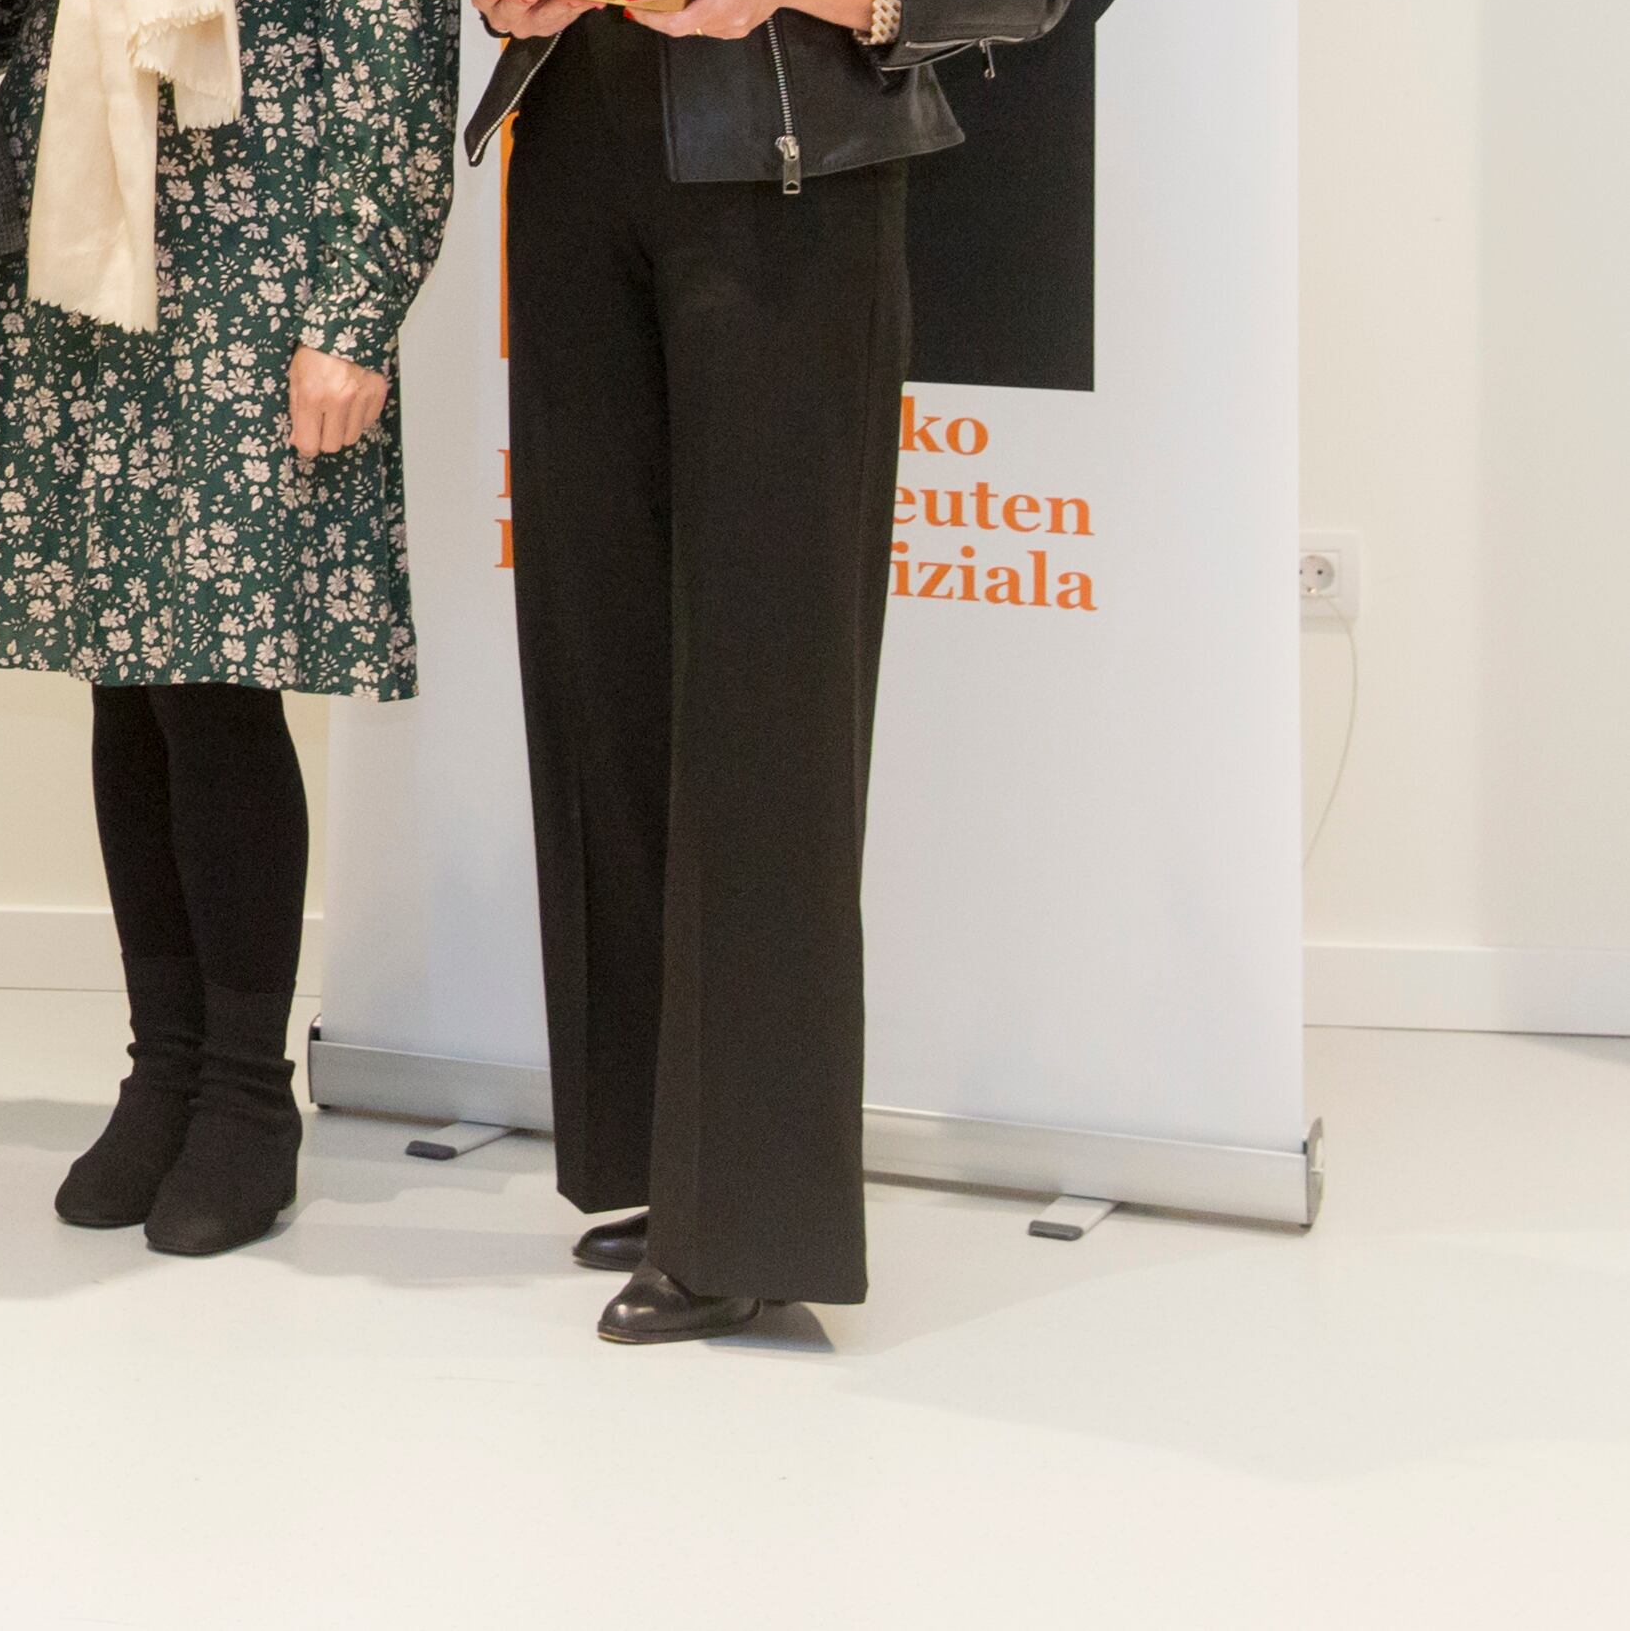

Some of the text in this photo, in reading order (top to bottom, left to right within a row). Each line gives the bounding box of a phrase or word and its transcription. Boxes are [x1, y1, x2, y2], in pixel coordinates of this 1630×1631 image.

[899, 396, 989, 455] ko
[893, 482, 1095, 536] euten
[890, 541, 1098, 612] iziala
